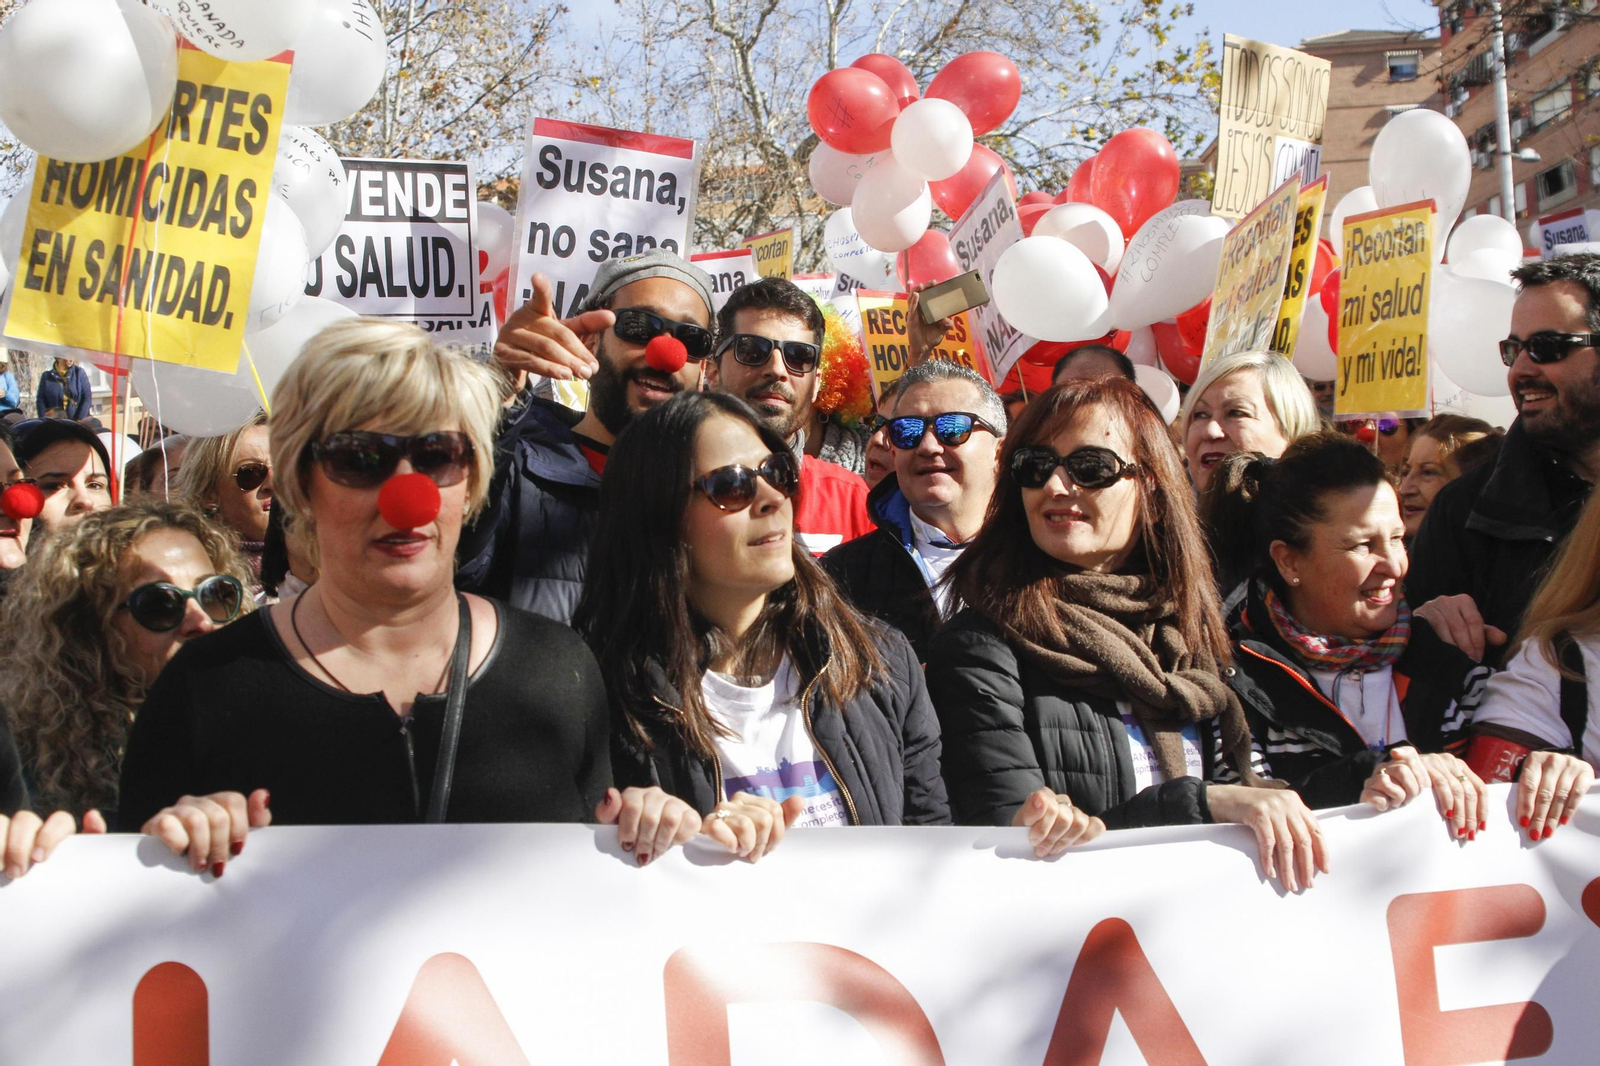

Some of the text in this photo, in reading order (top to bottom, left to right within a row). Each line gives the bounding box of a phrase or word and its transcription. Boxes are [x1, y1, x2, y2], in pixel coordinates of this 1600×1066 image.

[41, 157, 257, 239] HOMICIDAS
[536, 144, 686, 215] Susana,
[335, 234, 465, 298] SALUD.
[527, 221, 576, 258] no
[956, 197, 1014, 272] Susana,
[24, 228, 76, 296] EN
[78, 239, 234, 330] SANIDAD.
[1342, 272, 1426, 328] mi salud
[1341, 334, 1423, 396] y mi vida!
